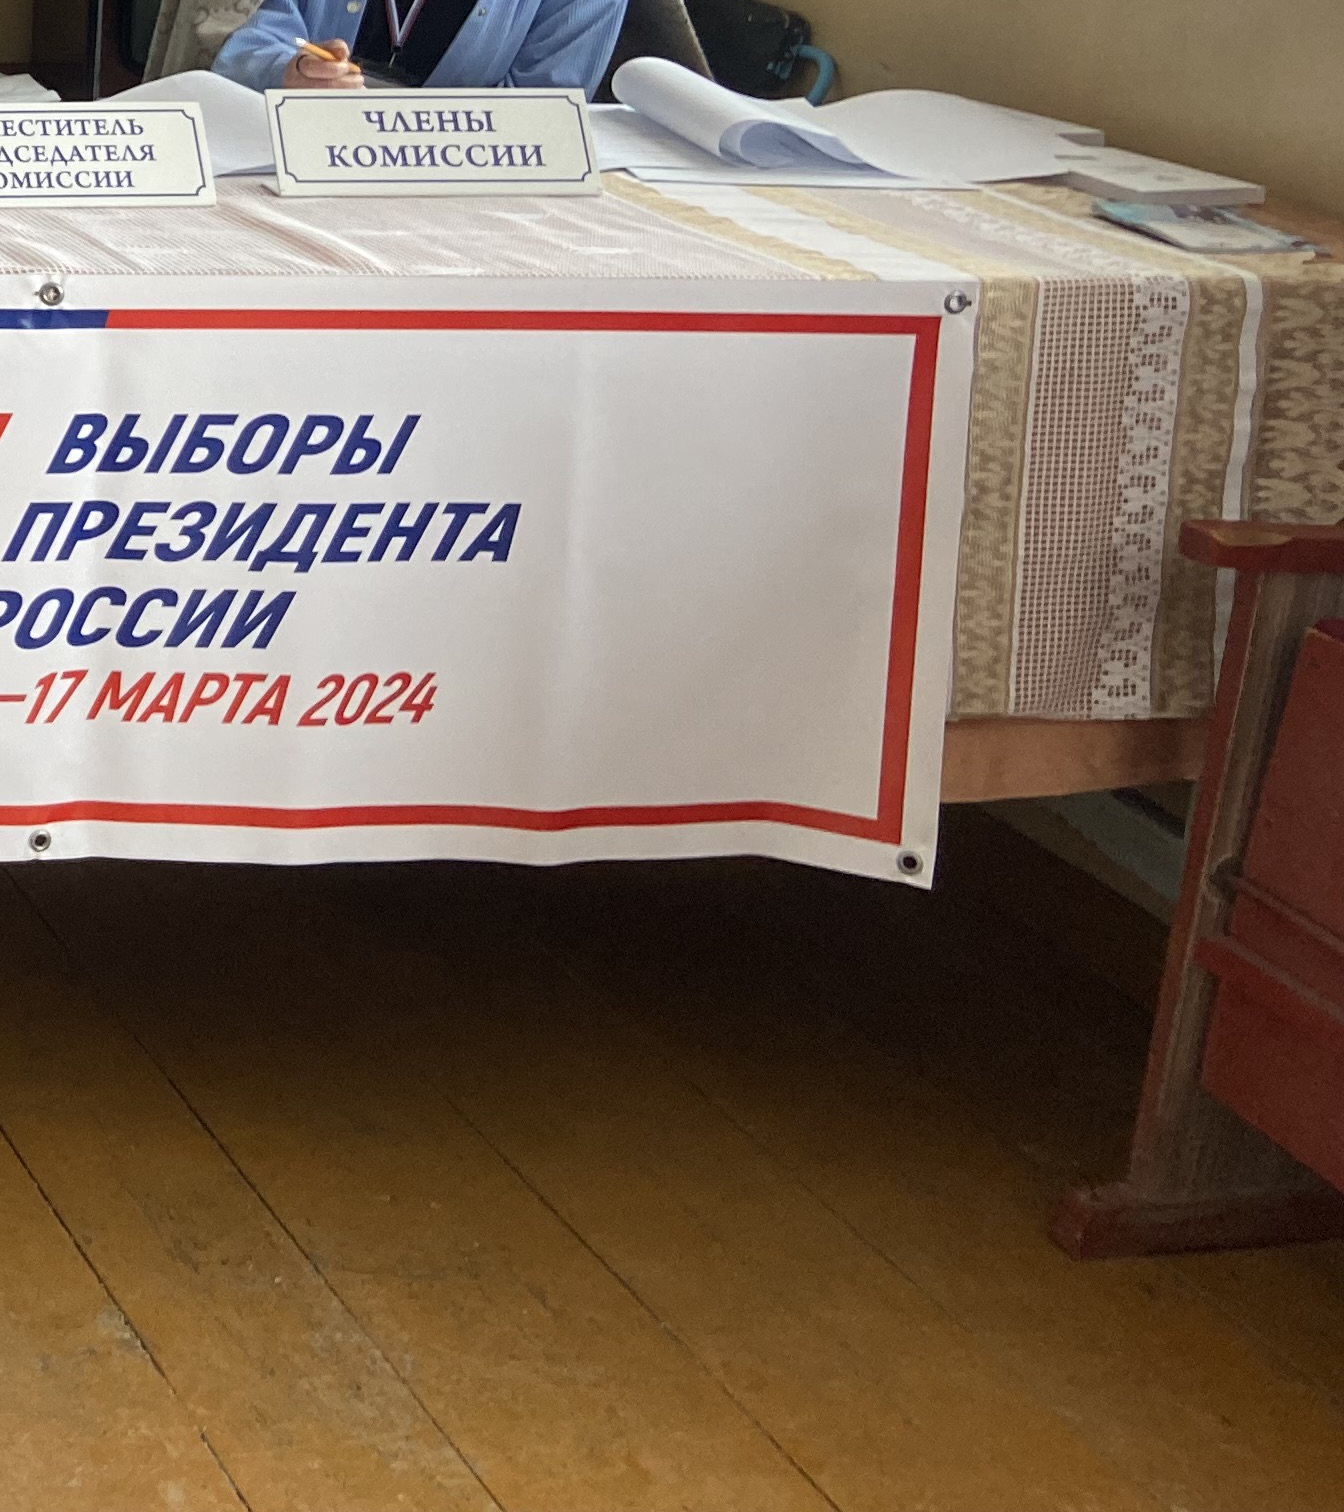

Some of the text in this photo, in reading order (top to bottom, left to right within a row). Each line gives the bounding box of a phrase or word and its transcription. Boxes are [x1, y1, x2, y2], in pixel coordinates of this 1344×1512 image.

[362, 110, 497, 134] ЧЛЕНЫ
[325, 144, 547, 169] КОМИССИИ
[44, 413, 422, 476] ВЫБОРЫ
[1, 501, 523, 575] ПРЕЗИДЕНТА
[84, 671, 287, 726] МАРТА
[295, 671, 440, 728] 2024
